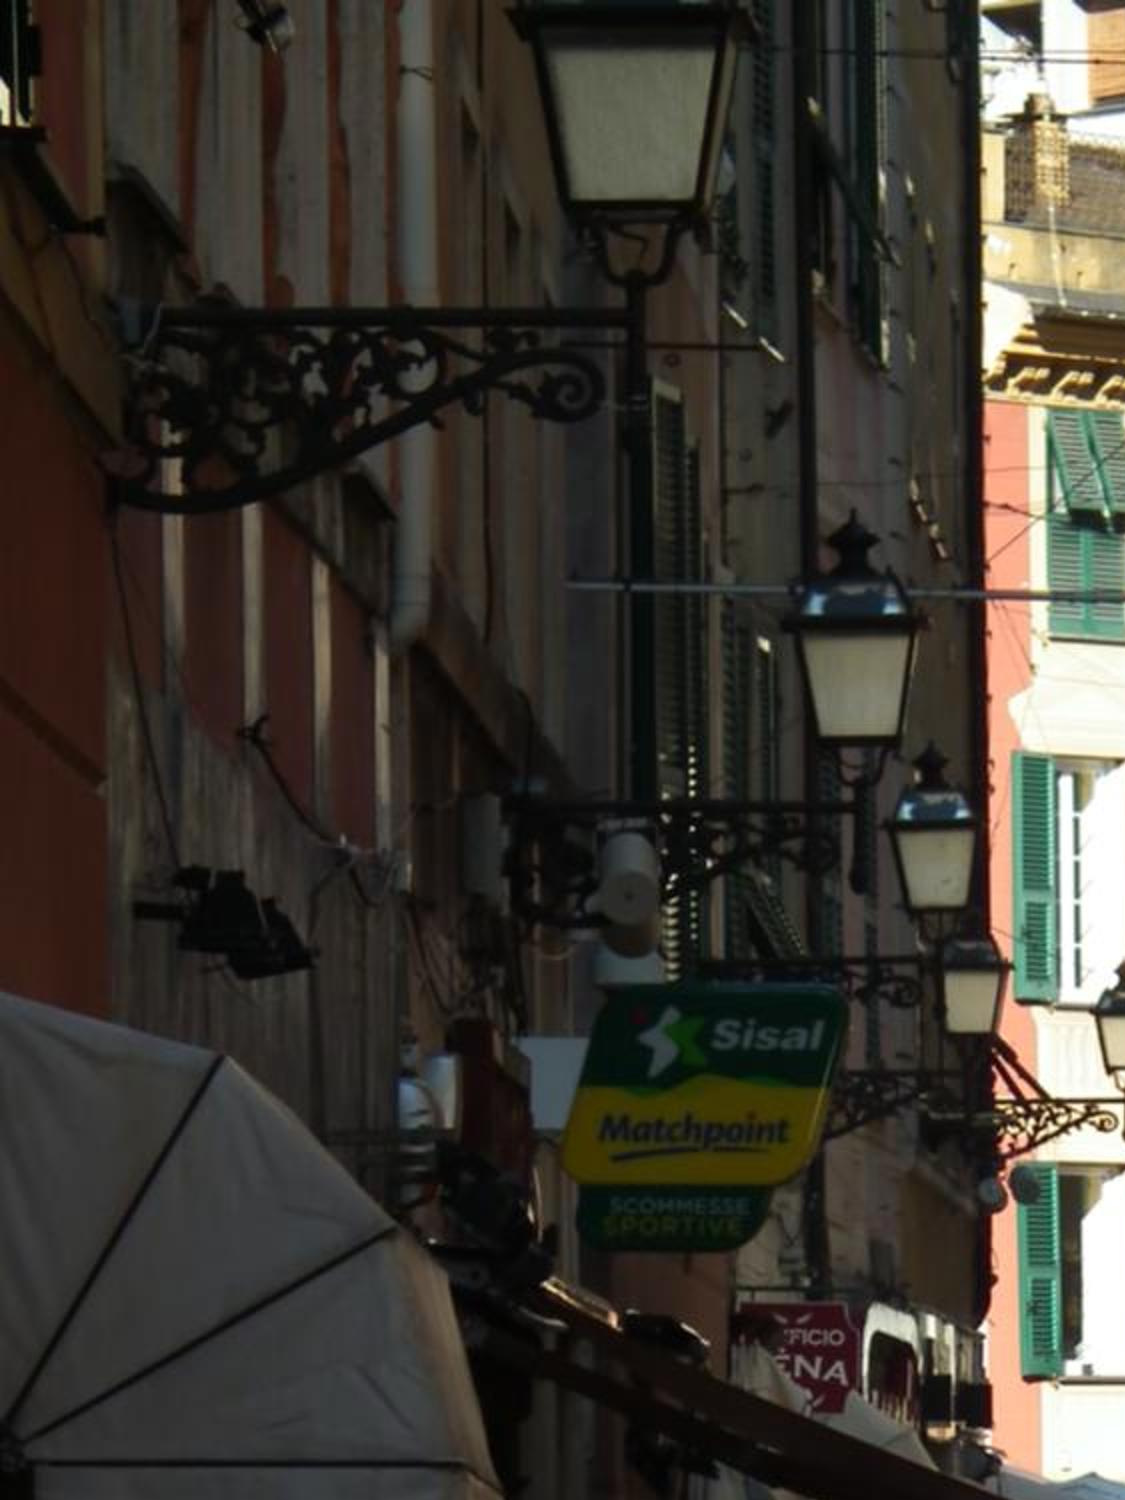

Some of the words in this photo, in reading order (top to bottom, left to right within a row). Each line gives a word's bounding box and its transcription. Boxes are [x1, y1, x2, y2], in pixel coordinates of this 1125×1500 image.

[711, 1017, 825, 1051] Sisal
[597, 1111, 790, 1147] Matchpoint
[610, 1196, 751, 1216] SCOMMESSE
[602, 1215, 742, 1237] SPORTIVE
[784, 1328, 846, 1347] FICIO
